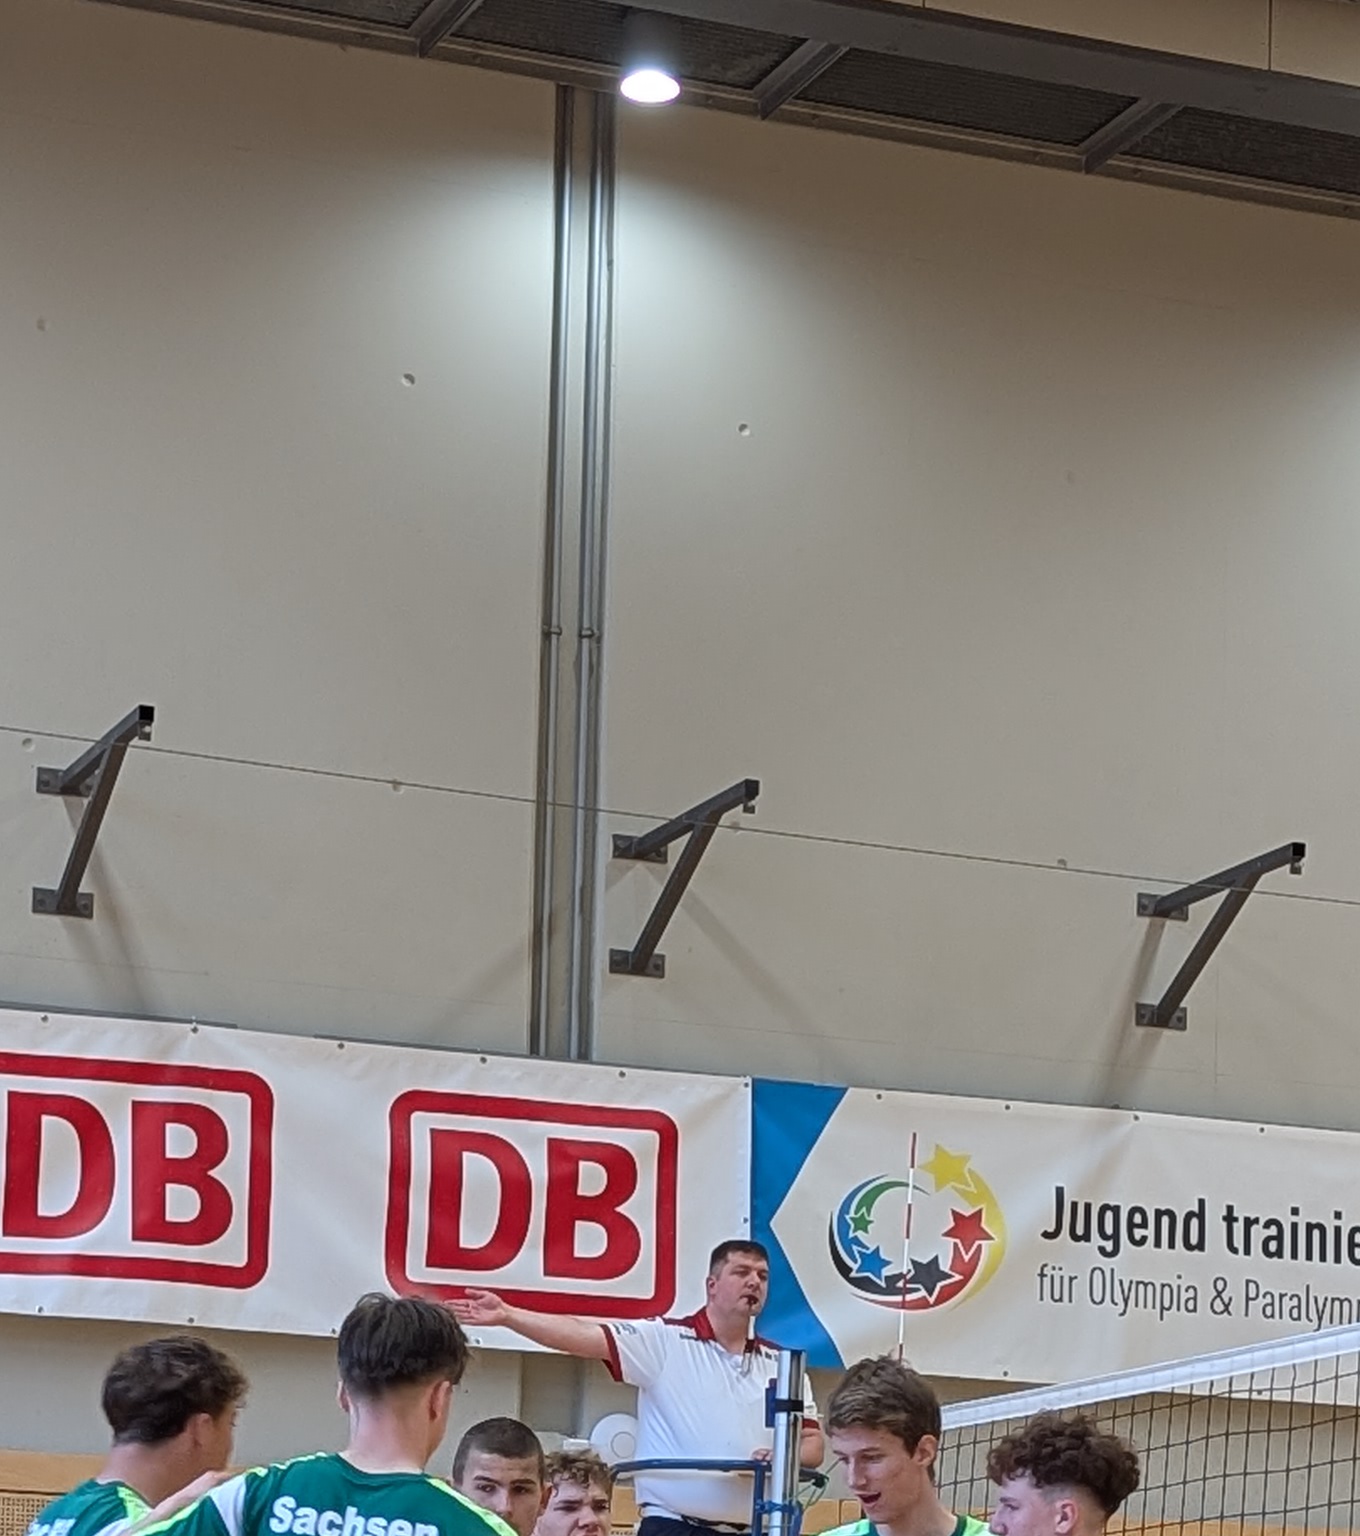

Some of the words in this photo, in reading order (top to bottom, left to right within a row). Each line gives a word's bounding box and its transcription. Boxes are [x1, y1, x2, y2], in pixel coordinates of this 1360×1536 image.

[1, 1090, 234, 1247] DB
[425, 1128, 643, 1281] DB
[1040, 1185, 1207, 1257] Jugend
[1037, 1264, 1079, 1305] für
[1089, 1266, 1199, 1323] Olympia
[1210, 1276, 1234, 1318] &
